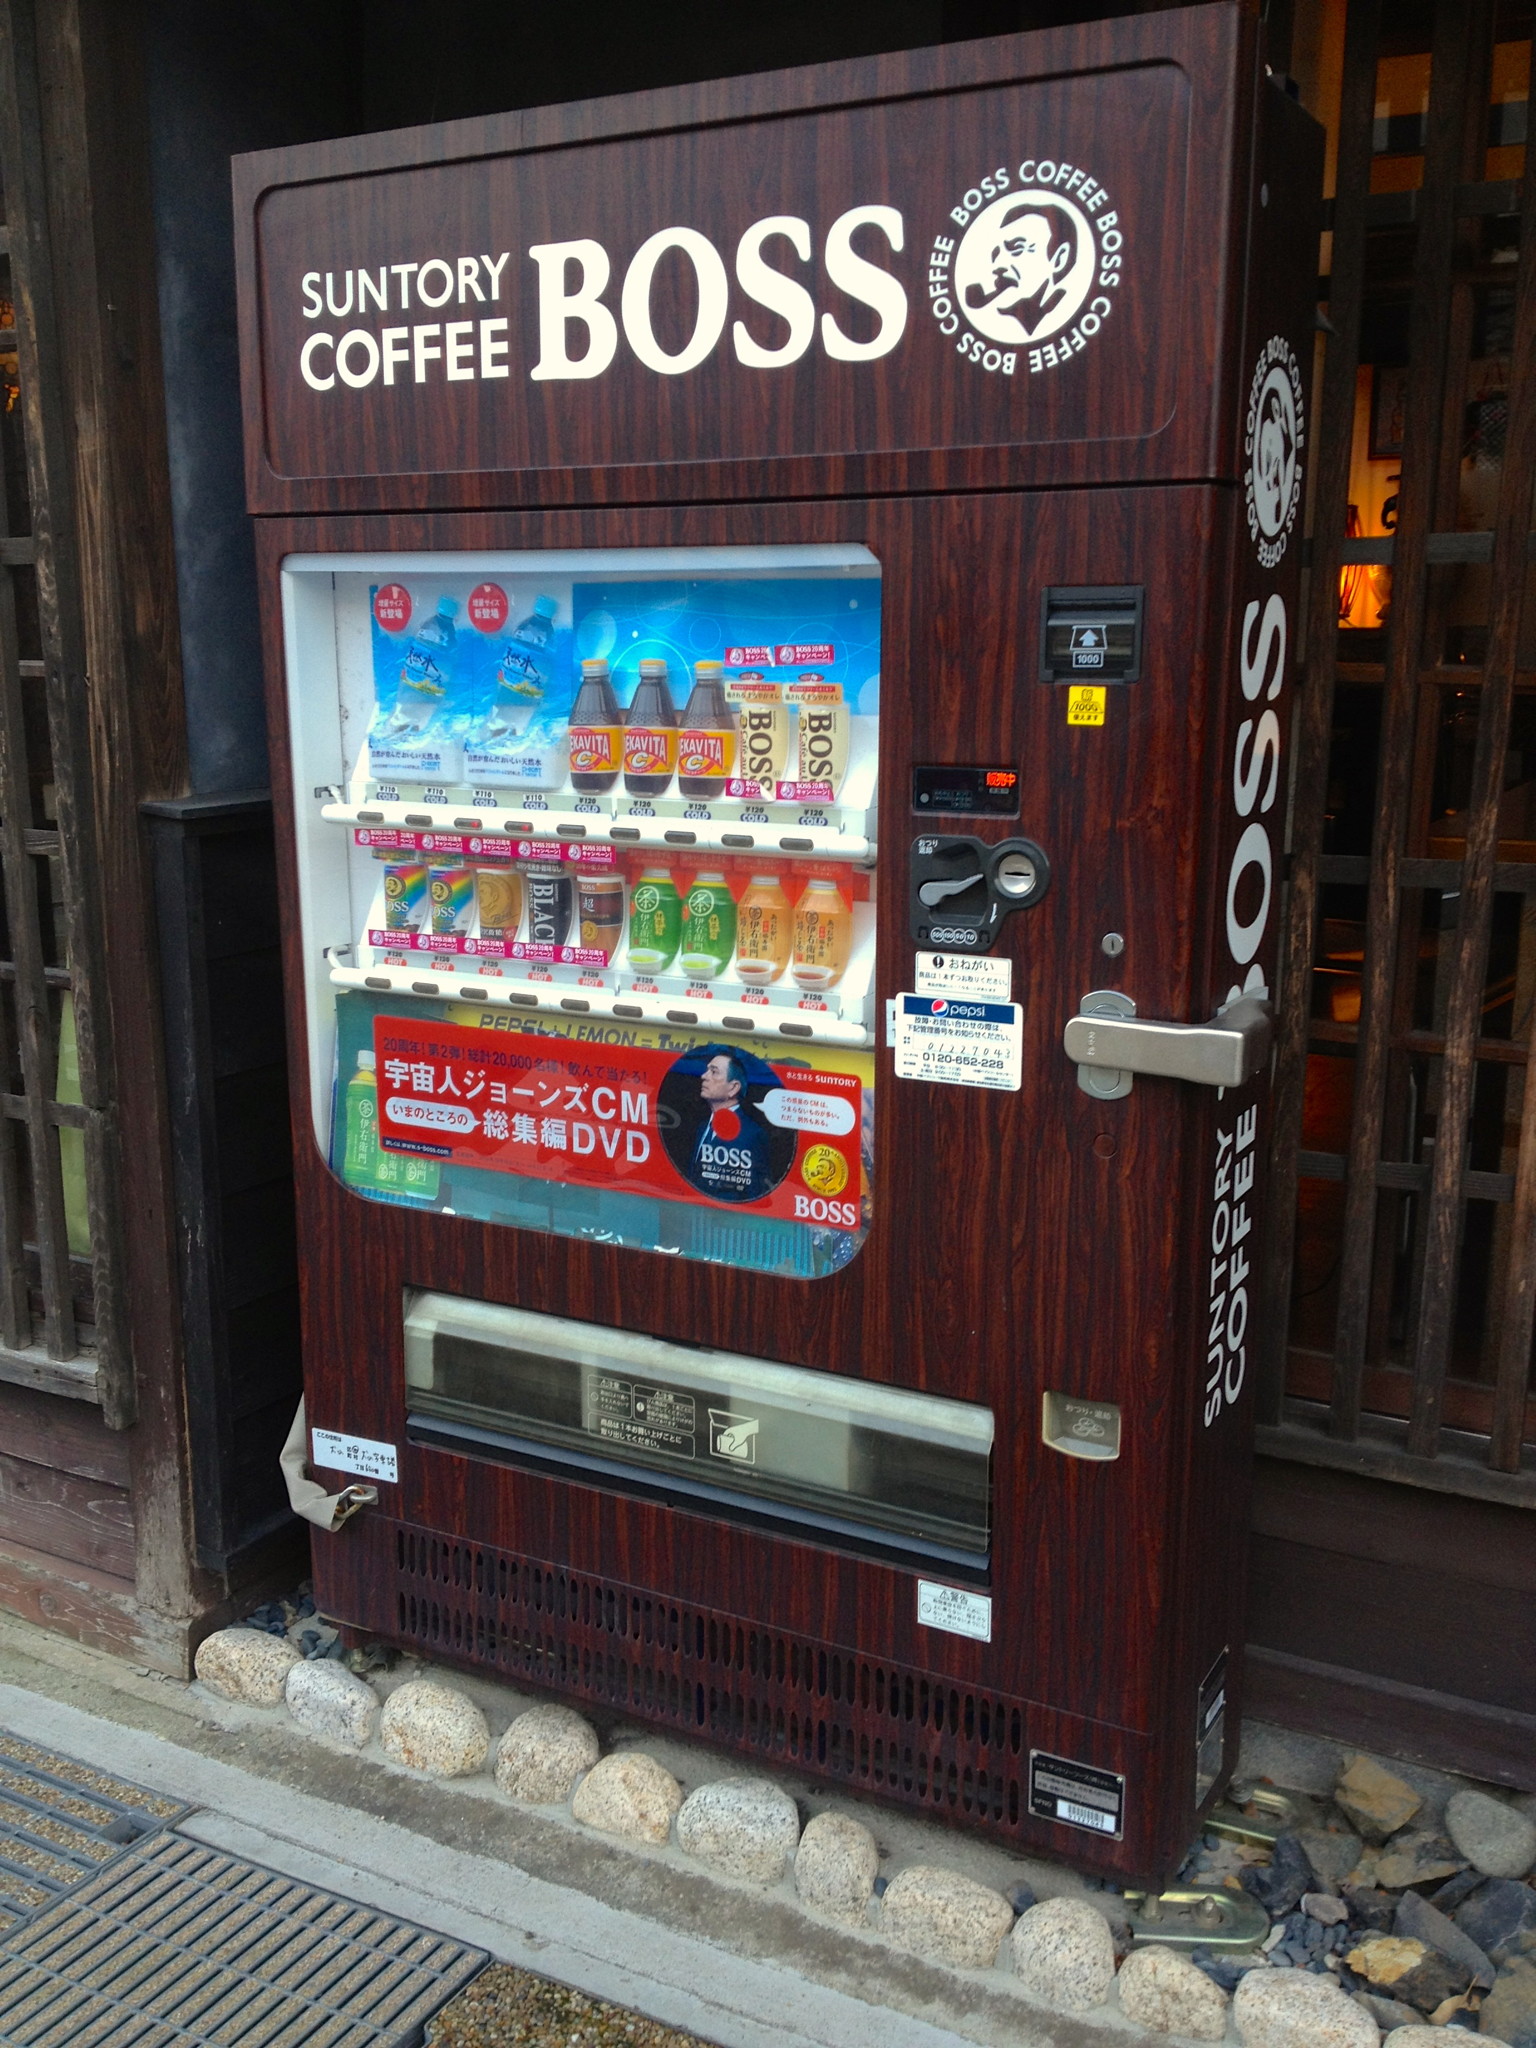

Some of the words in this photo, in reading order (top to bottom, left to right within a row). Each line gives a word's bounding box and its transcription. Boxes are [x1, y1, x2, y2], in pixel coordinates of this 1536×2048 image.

[950, 167, 1010, 226] BOSS
[1019, 160, 1109, 212] COFFEE
[1096, 210, 1123, 287] BOSS
[302, 253, 510, 318] SUNTORY
[528, 204, 908, 381] BOSS
[928, 235, 959, 335] COFFEE
[1028, 296, 1111, 373] COFFEE
[300, 317, 509, 391] COFFEE
[956, 332, 1017, 375] BOSS
[1266, 334, 1290, 365] BOSS
[1244, 348, 1267, 456] COFFEE
[1284, 464, 1303, 534] BOSS
[379, 608, 403, 619] 新登場
[474, 608, 500, 620] 新登場
[1077, 654, 1100, 664] 1000
[1074, 703, 1098, 712] 1000
[569, 734, 611, 762] EKAVITA
[625, 735, 667, 762] EKAVITA
[679, 737, 722, 767] EKAVITA
[576, 751, 592, 766] C
[631, 752, 648, 768] C
[686, 755, 704, 771] C
[986, 772, 1016, 787] 販売中
[379, 785, 396, 793] ¥110
[427, 788, 444, 796] ¥110
[475, 790, 492, 798] ¥110
[377, 793, 398, 801] COLD
[425, 796, 446, 804] COLD
[474, 799, 496, 807] COLD
[525, 794, 543, 802] ¥110
[524, 802, 547, 810] COLD
[576, 805, 599, 813] COLD
[631, 808, 654, 816] COLD
[685, 811, 709, 820] COLD
[742, 814, 766, 823] COLD
[800, 817, 826, 826] COLD
[918, 839, 938, 847] おつり
[1216, 593, 1287, 1100] OSS
[386, 901, 409, 912] OSS
[433, 906, 456, 917] OSS
[533, 884, 556, 945] BLAC
[749, 920, 759, 958] 伊右衛門
[806, 925, 815, 965] 伊右衛門
[387, 957, 402, 966] HOT
[434, 962, 449, 970] HOT
[949, 958, 994, 971] おねがい
[482, 967, 498, 976] HOT
[531, 973, 548, 981] HOT
[919, 971, 1008, 986] 商品は1本ずつお取りください。
[582, 978, 599, 986] HOT
[636, 984, 654, 993] HOT
[690, 990, 708, 998] HOT
[745, 995, 765, 1004] HOT
[803, 1001, 823, 1011] HOT
[949, 1005, 986, 1018] pepsi
[914, 1016, 1002, 1032] 故障・お問い合わせの際は、
[906, 1024, 1012, 1042] 下記管理番号をお知らせください。
[922, 1052, 1004, 1070] 0120-652-228
[384, 1058, 649, 1125] 宇宙人ジョーンズCM
[393, 1104, 468, 1126] いまのところの
[358, 1118, 370, 1165] 伊右衛門
[483, 1108, 650, 1164] 総集編DVD
[701, 1143, 752, 1169] BOSS
[794, 1194, 856, 1226] BOSS
[1225, 1103, 1257, 1404] COFFEE
[1204, 1128, 1234, 1428] SUNTORY
[600, 1418, 682, 1444] 商品は1本お買い上げごとに
[600, 1427, 660, 1448] 取り出してください。
